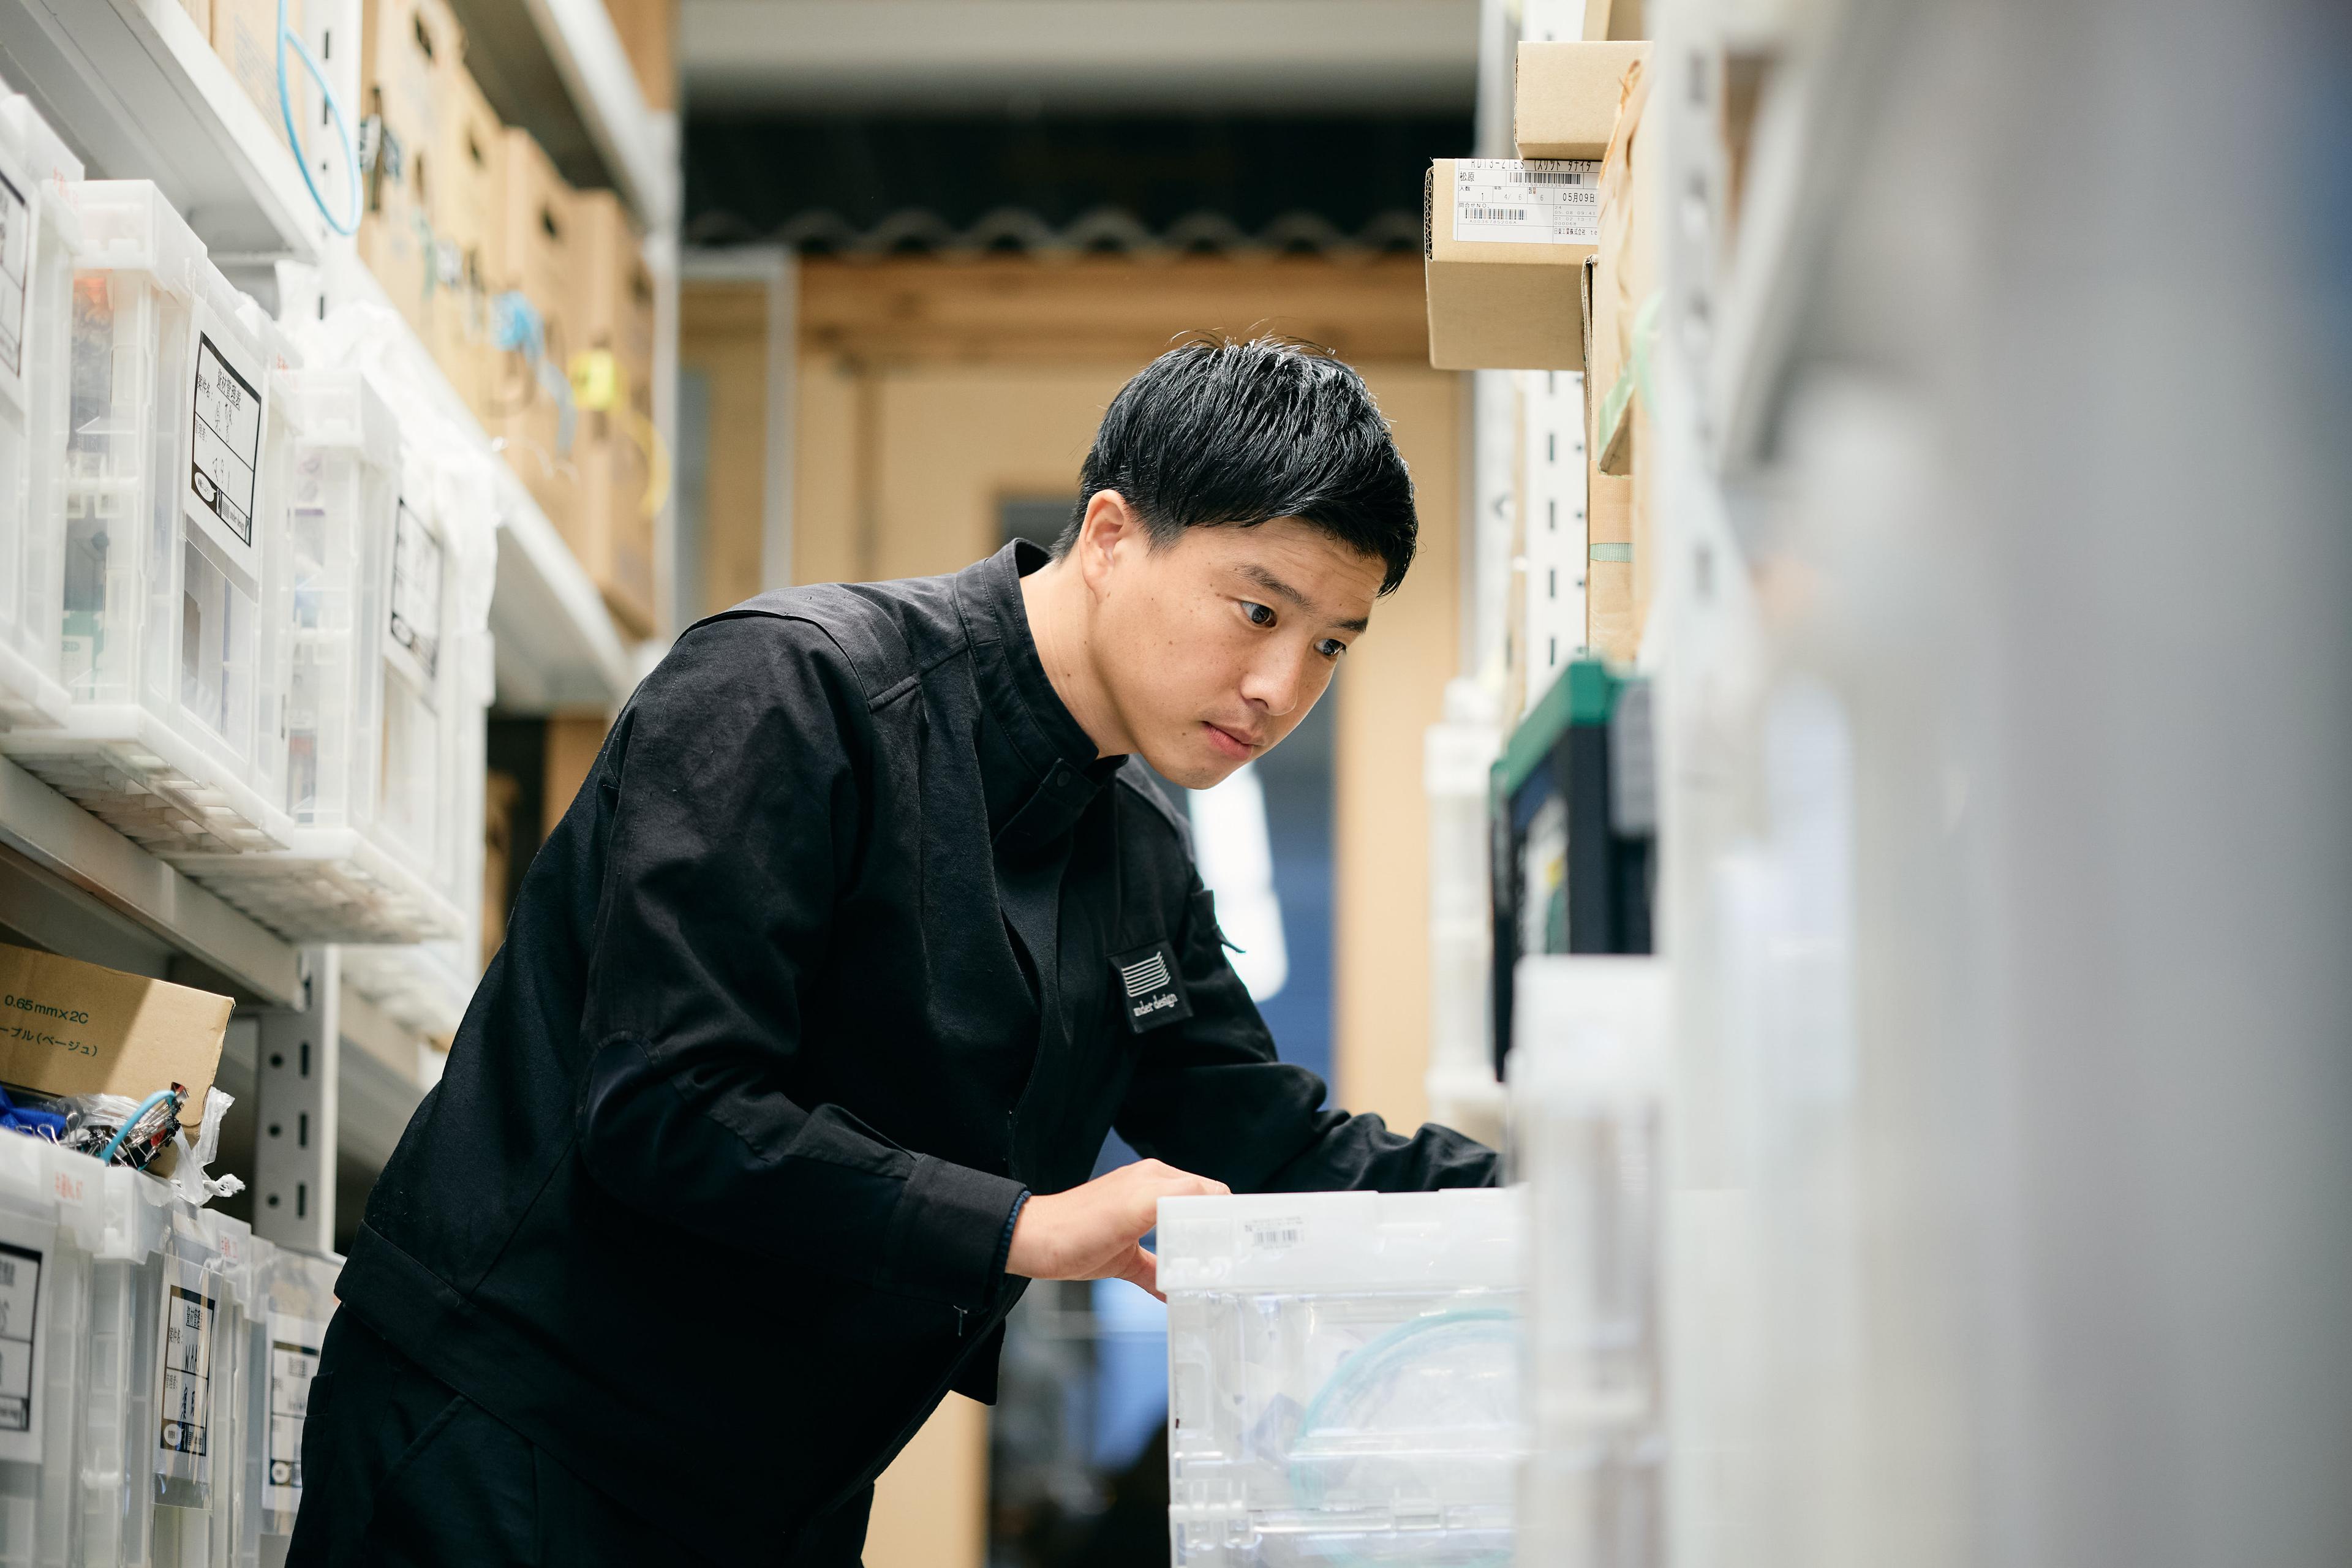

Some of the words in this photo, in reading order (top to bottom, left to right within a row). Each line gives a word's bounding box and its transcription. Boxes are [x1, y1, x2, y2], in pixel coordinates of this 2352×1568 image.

[1460, 172, 1475, 181] 松原
[1562, 193, 1594, 203] 05月09日
[1153, 993, 1178, 1009] design
